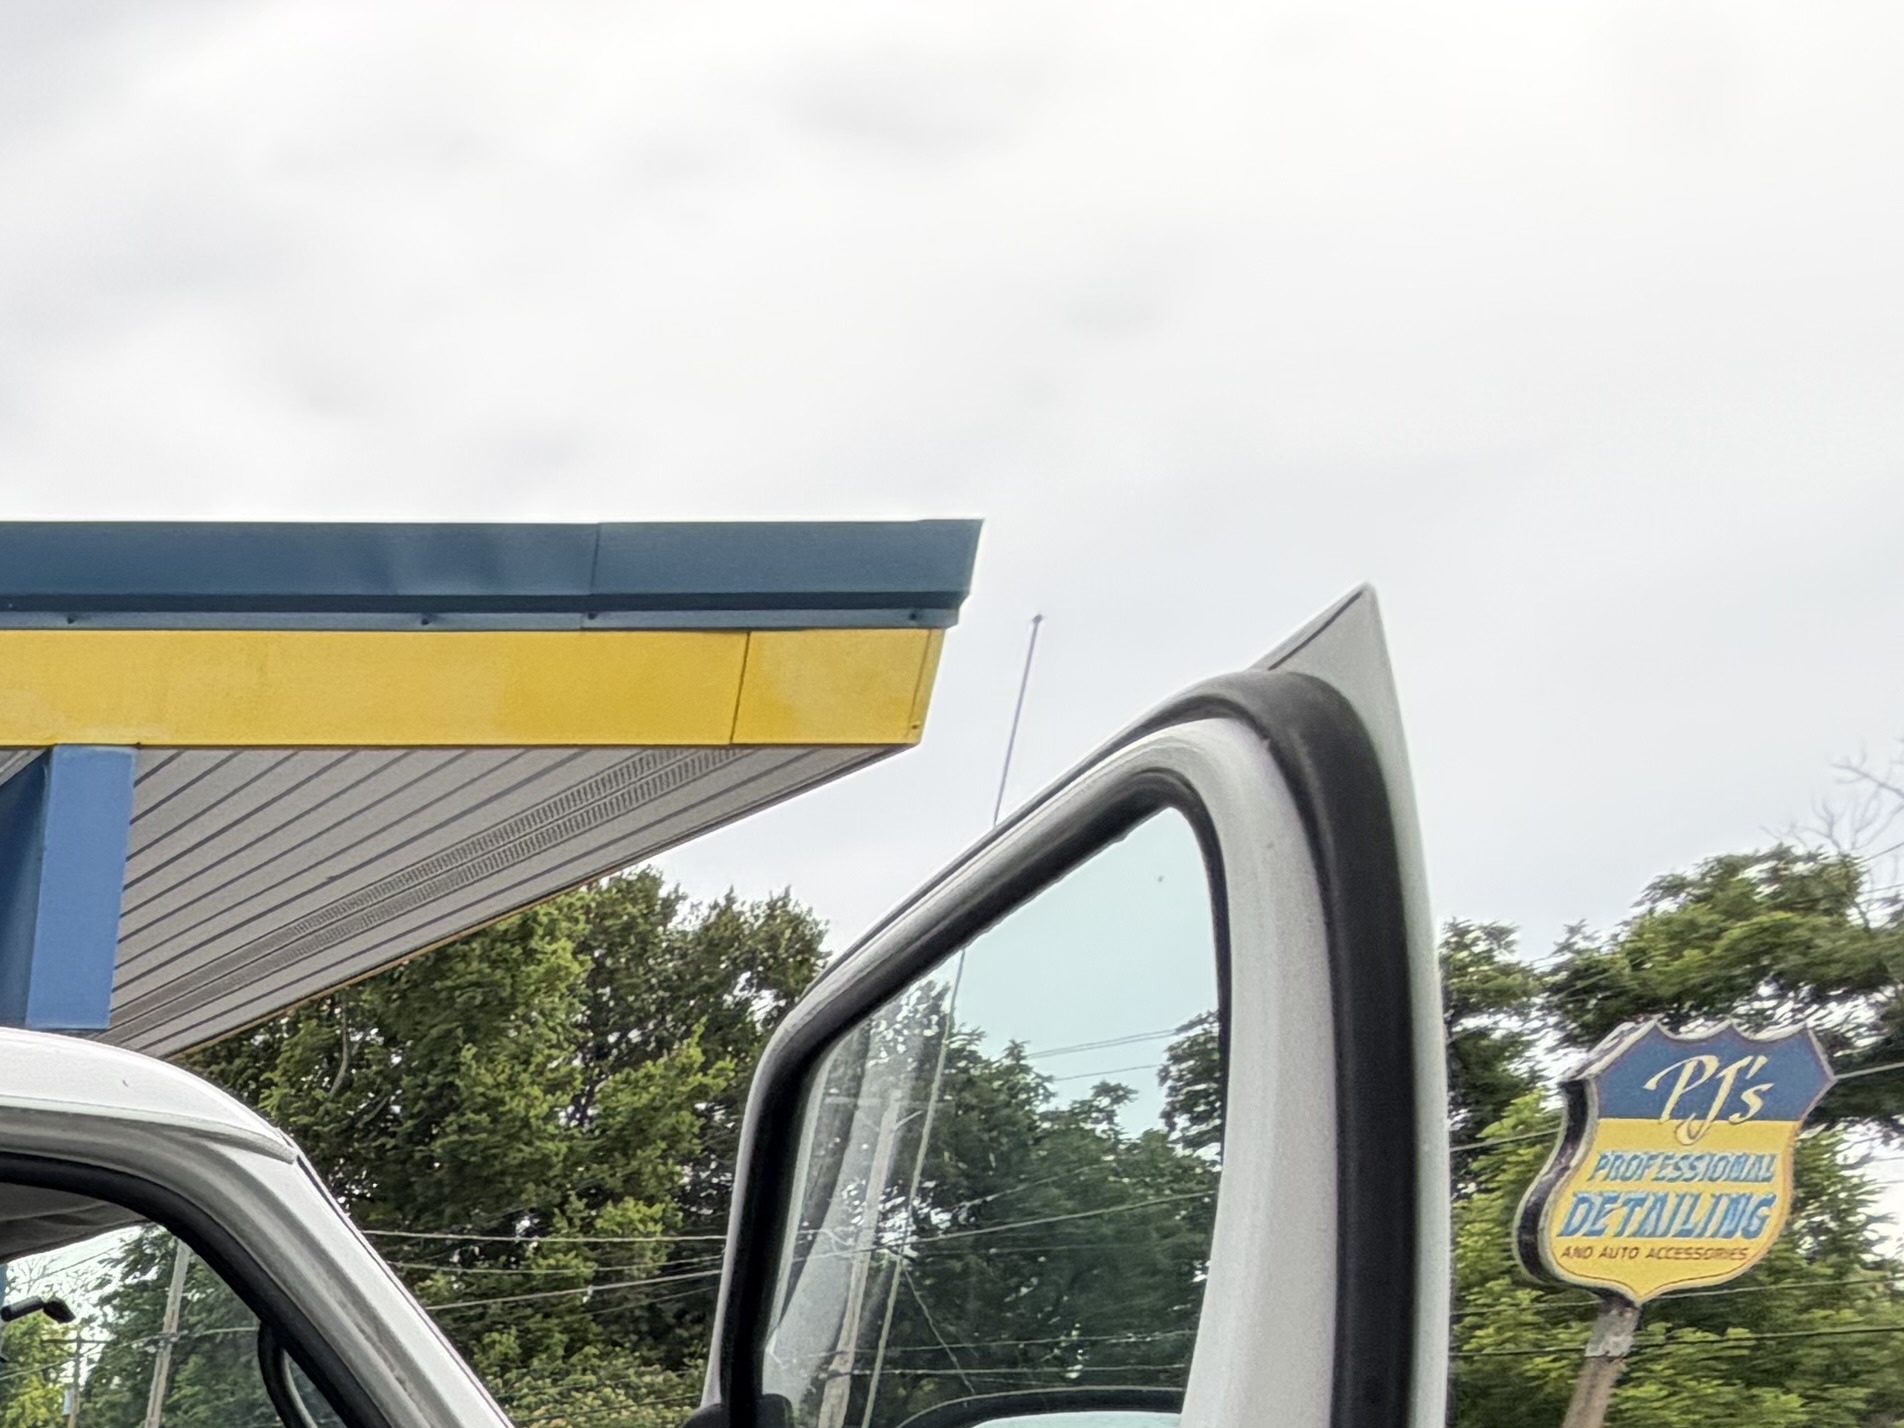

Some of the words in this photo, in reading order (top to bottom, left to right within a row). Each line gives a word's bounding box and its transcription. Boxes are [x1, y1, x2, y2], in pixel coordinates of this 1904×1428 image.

[1643, 1055, 1775, 1146] PJ's
[1589, 1152, 1777, 1182] PROFESSIONAL
[1556, 1192, 1777, 1240] DETAILING
[1560, 1245, 1592, 1260] AND
[1598, 1245, 1640, 1260] AUTO
[1645, 1246, 1750, 1261] ACCESSORIES
